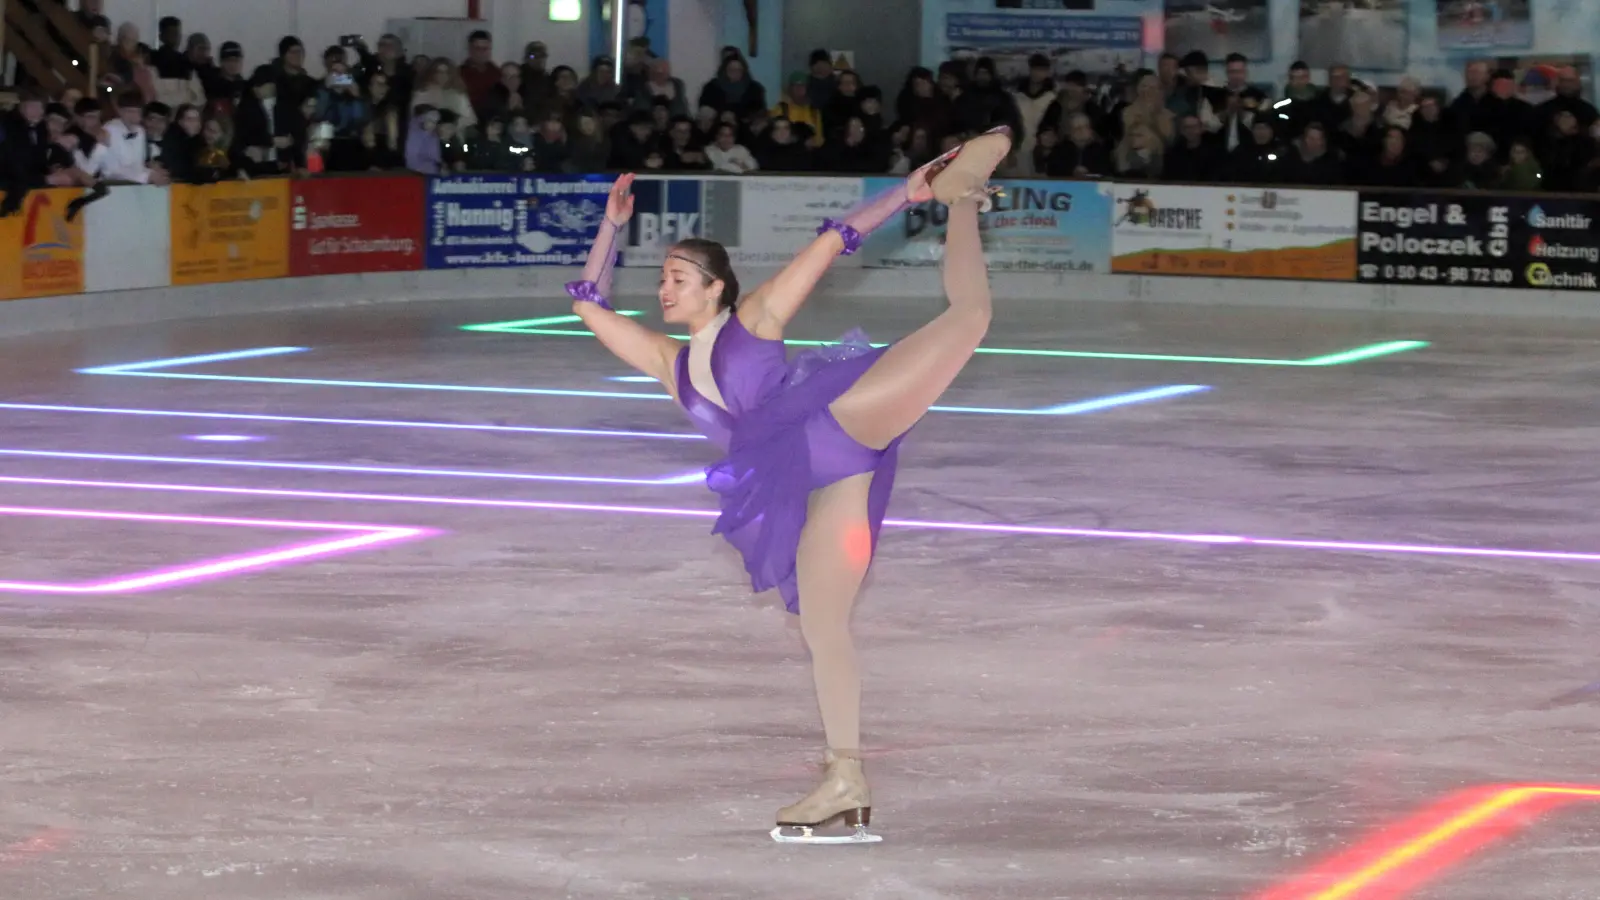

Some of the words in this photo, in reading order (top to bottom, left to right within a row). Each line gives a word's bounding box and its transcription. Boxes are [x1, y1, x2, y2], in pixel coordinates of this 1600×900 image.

[446, 201, 514, 232] Hannig
[994, 214, 1017, 228] the
[1021, 214, 1058, 229] clock
[1361, 201, 1438, 229] Engel
[1445, 203, 1467, 225] &
[1534, 213, 1593, 230] Sanitär
[1487, 206, 1509, 258] GbR
[1361, 231, 1483, 257] Poloczek
[1533, 243, 1600, 263] Heizung
[1384, 265, 1393, 278] 0
[1397, 265, 1416, 279] 50
[1419, 266, 1438, 281] 43
[1472, 268, 1490, 282] 72
[1536, 271, 1598, 289] Technik
